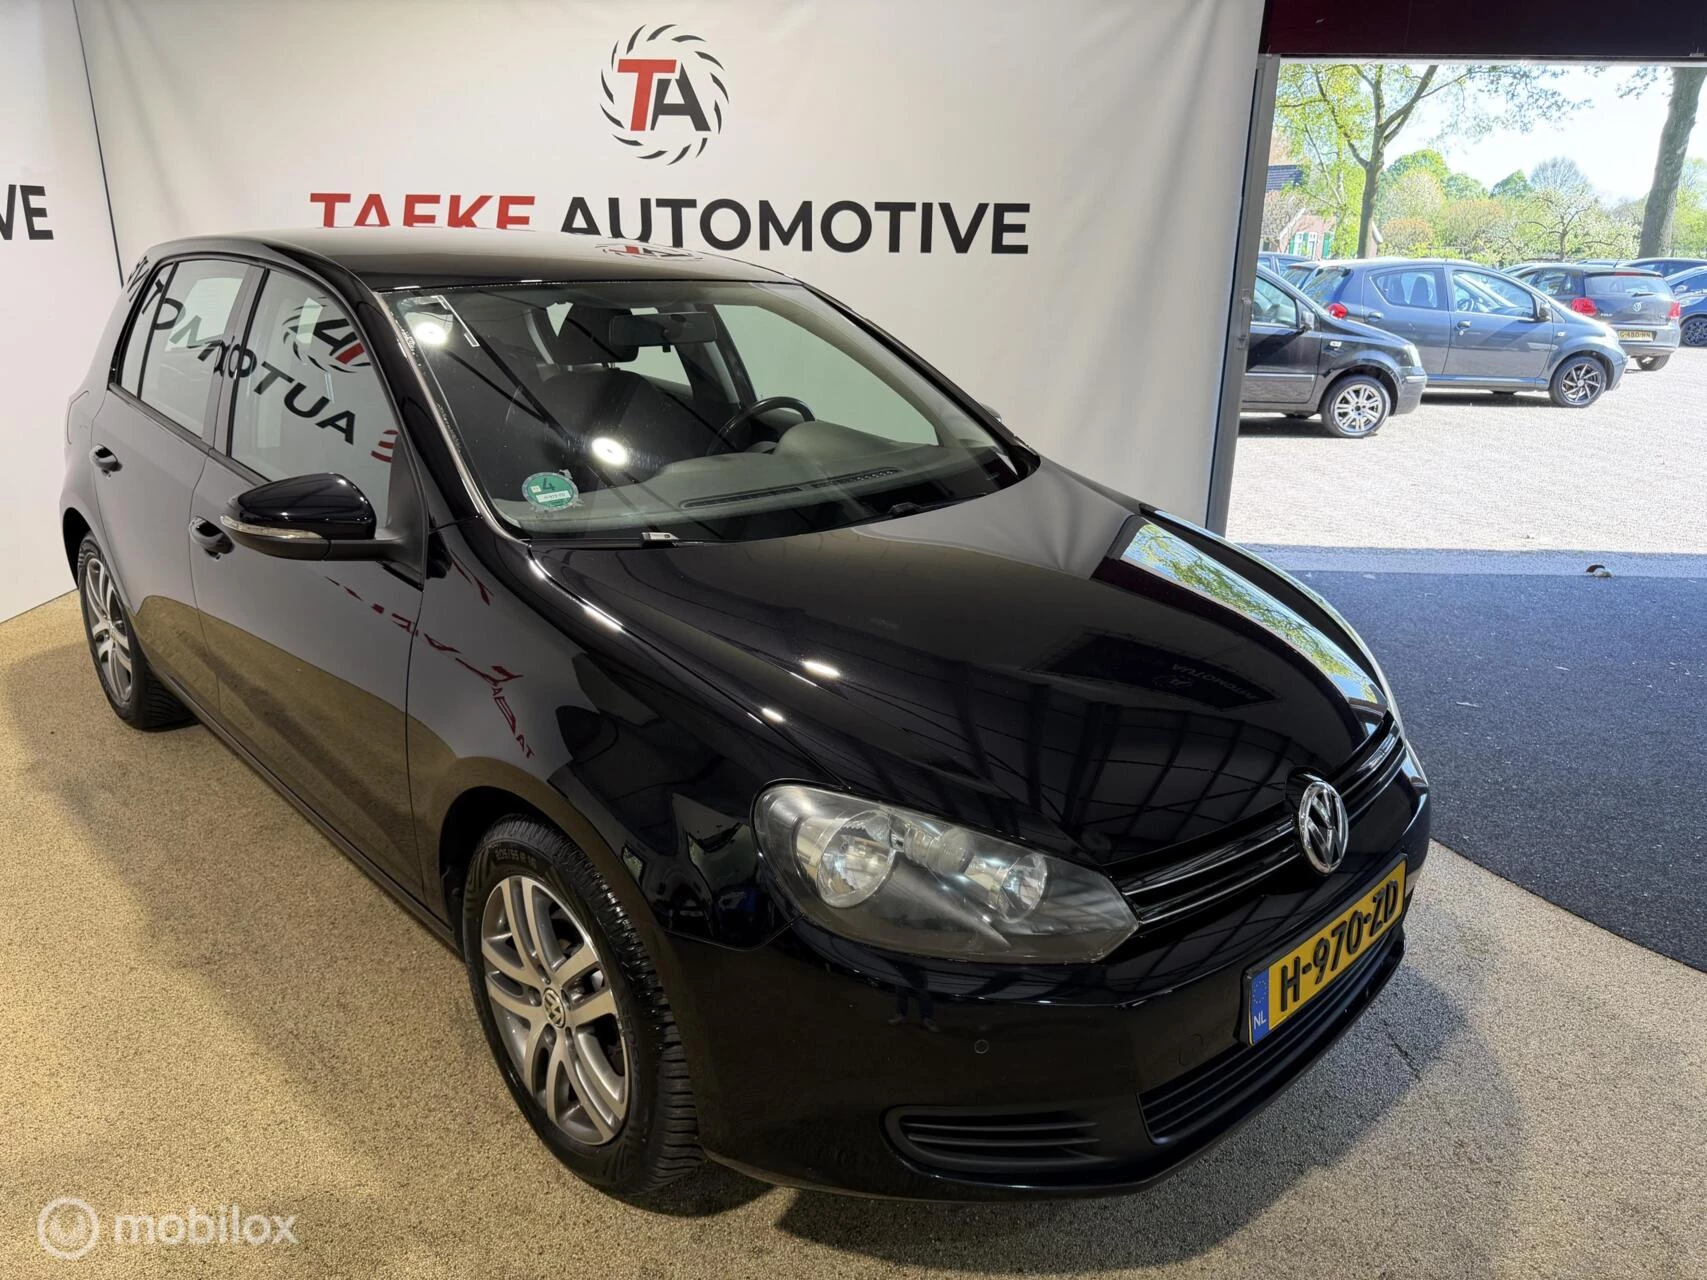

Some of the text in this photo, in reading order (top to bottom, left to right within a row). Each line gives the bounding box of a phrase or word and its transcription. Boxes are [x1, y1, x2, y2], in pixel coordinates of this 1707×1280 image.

[617, 58, 712, 132] TA
[310, 192, 1031, 255] TAEKE AUTOMOTIVE
[1280, 879, 1399, 1013] H-970-ZD
[1253, 1012, 1267, 1030] NL
